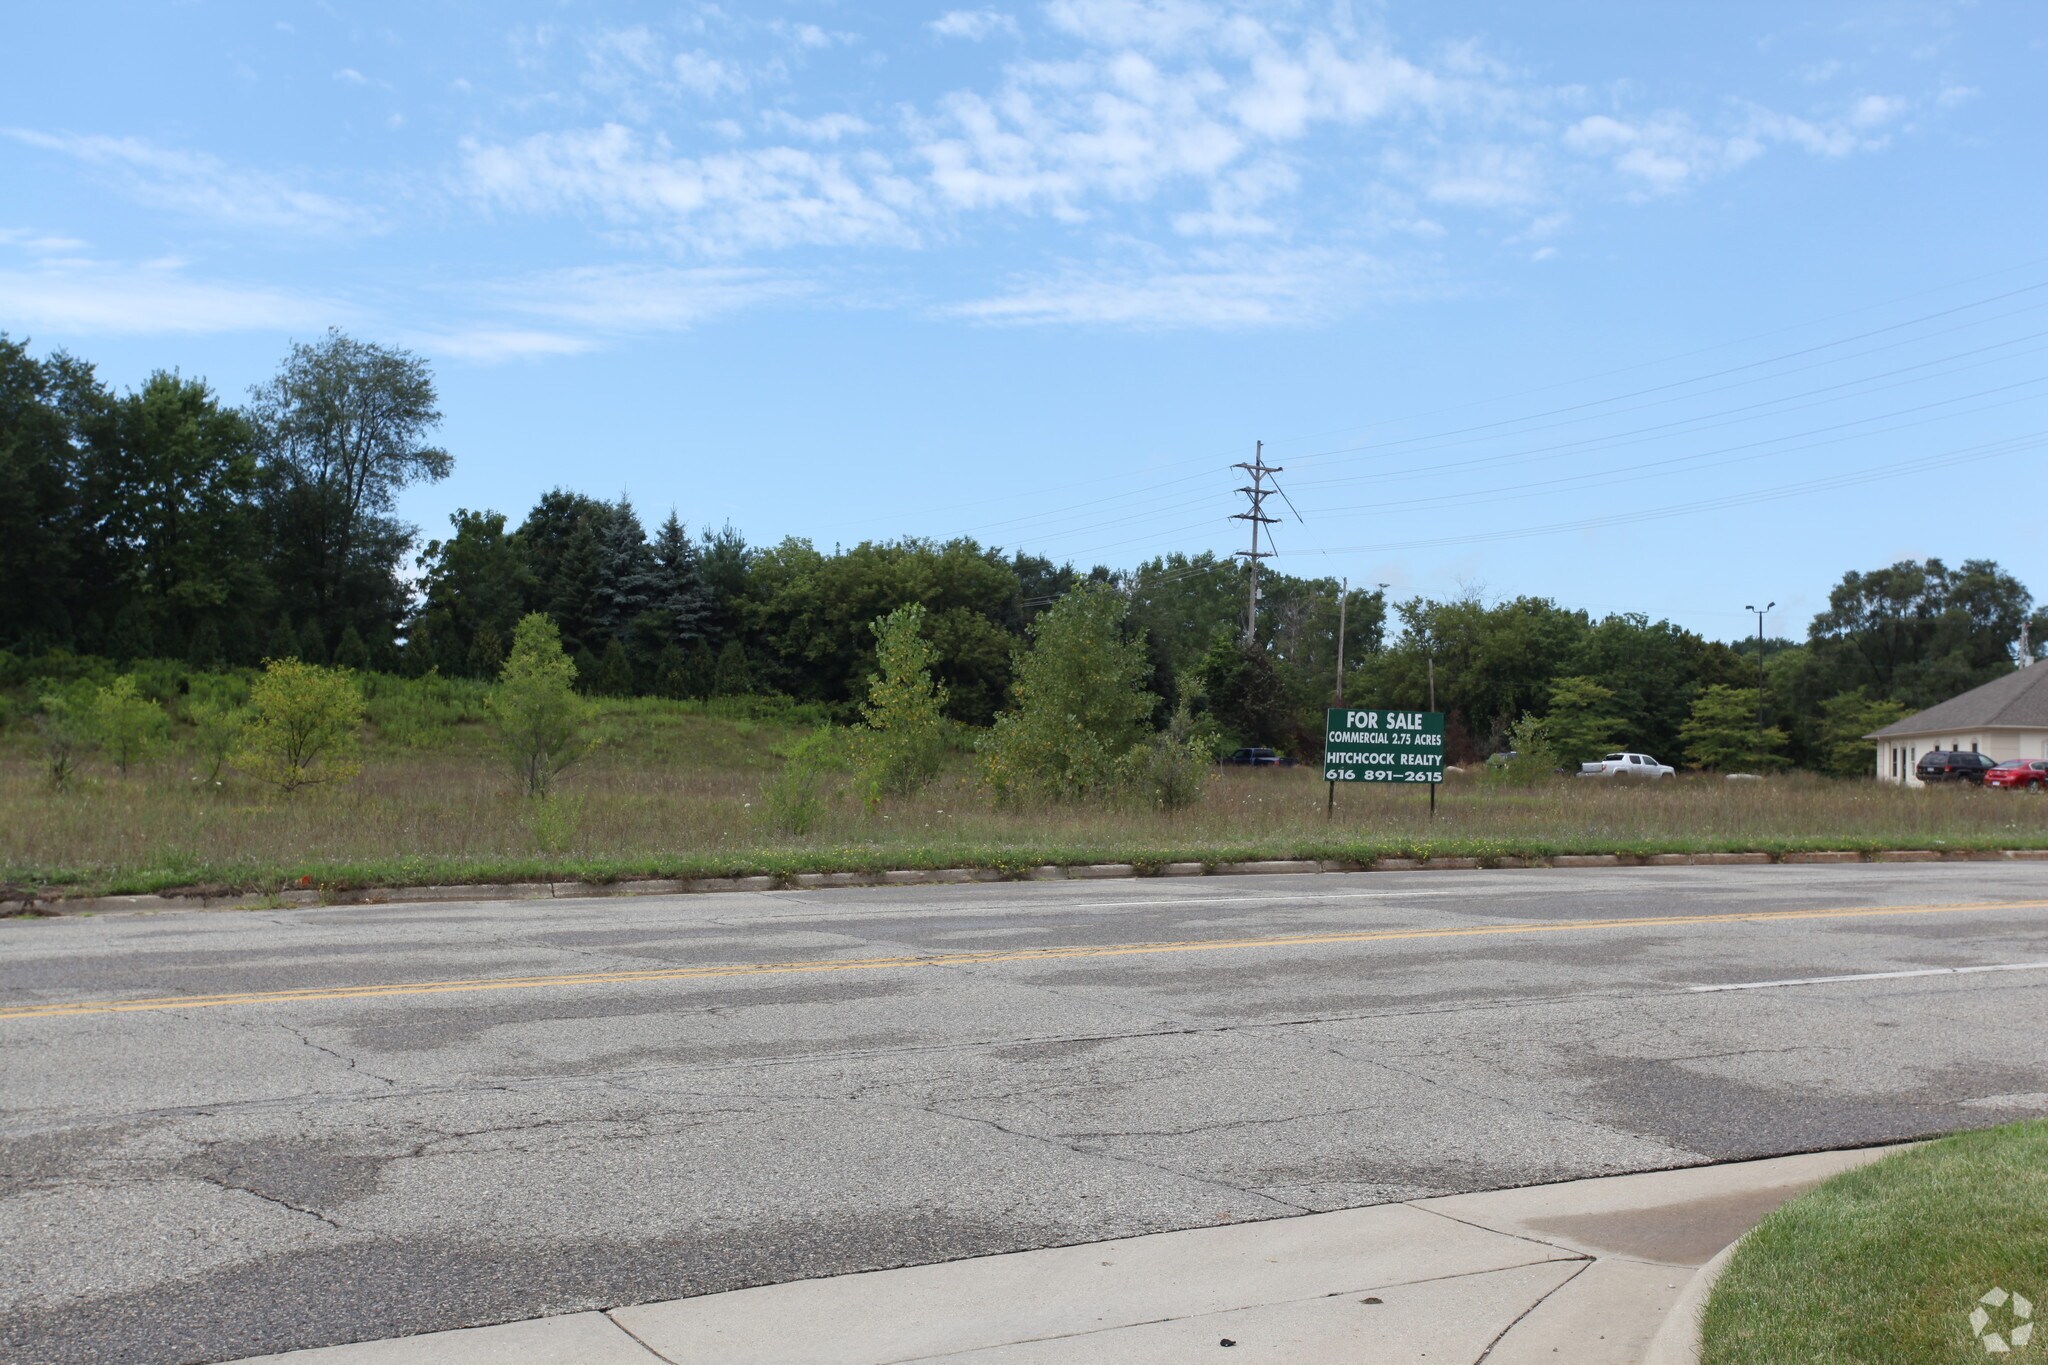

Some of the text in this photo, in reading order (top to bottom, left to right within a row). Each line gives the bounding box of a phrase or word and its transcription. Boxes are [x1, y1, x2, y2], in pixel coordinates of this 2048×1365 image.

[1347, 711, 1422, 730] FOR SALE
[1329, 731, 1441, 746] COMMERCIAL 2.75 ACRES
[1327, 752, 1442, 766] HITCHCOCK REALTY
[1326, 769, 1442, 782] 616 891-2615
